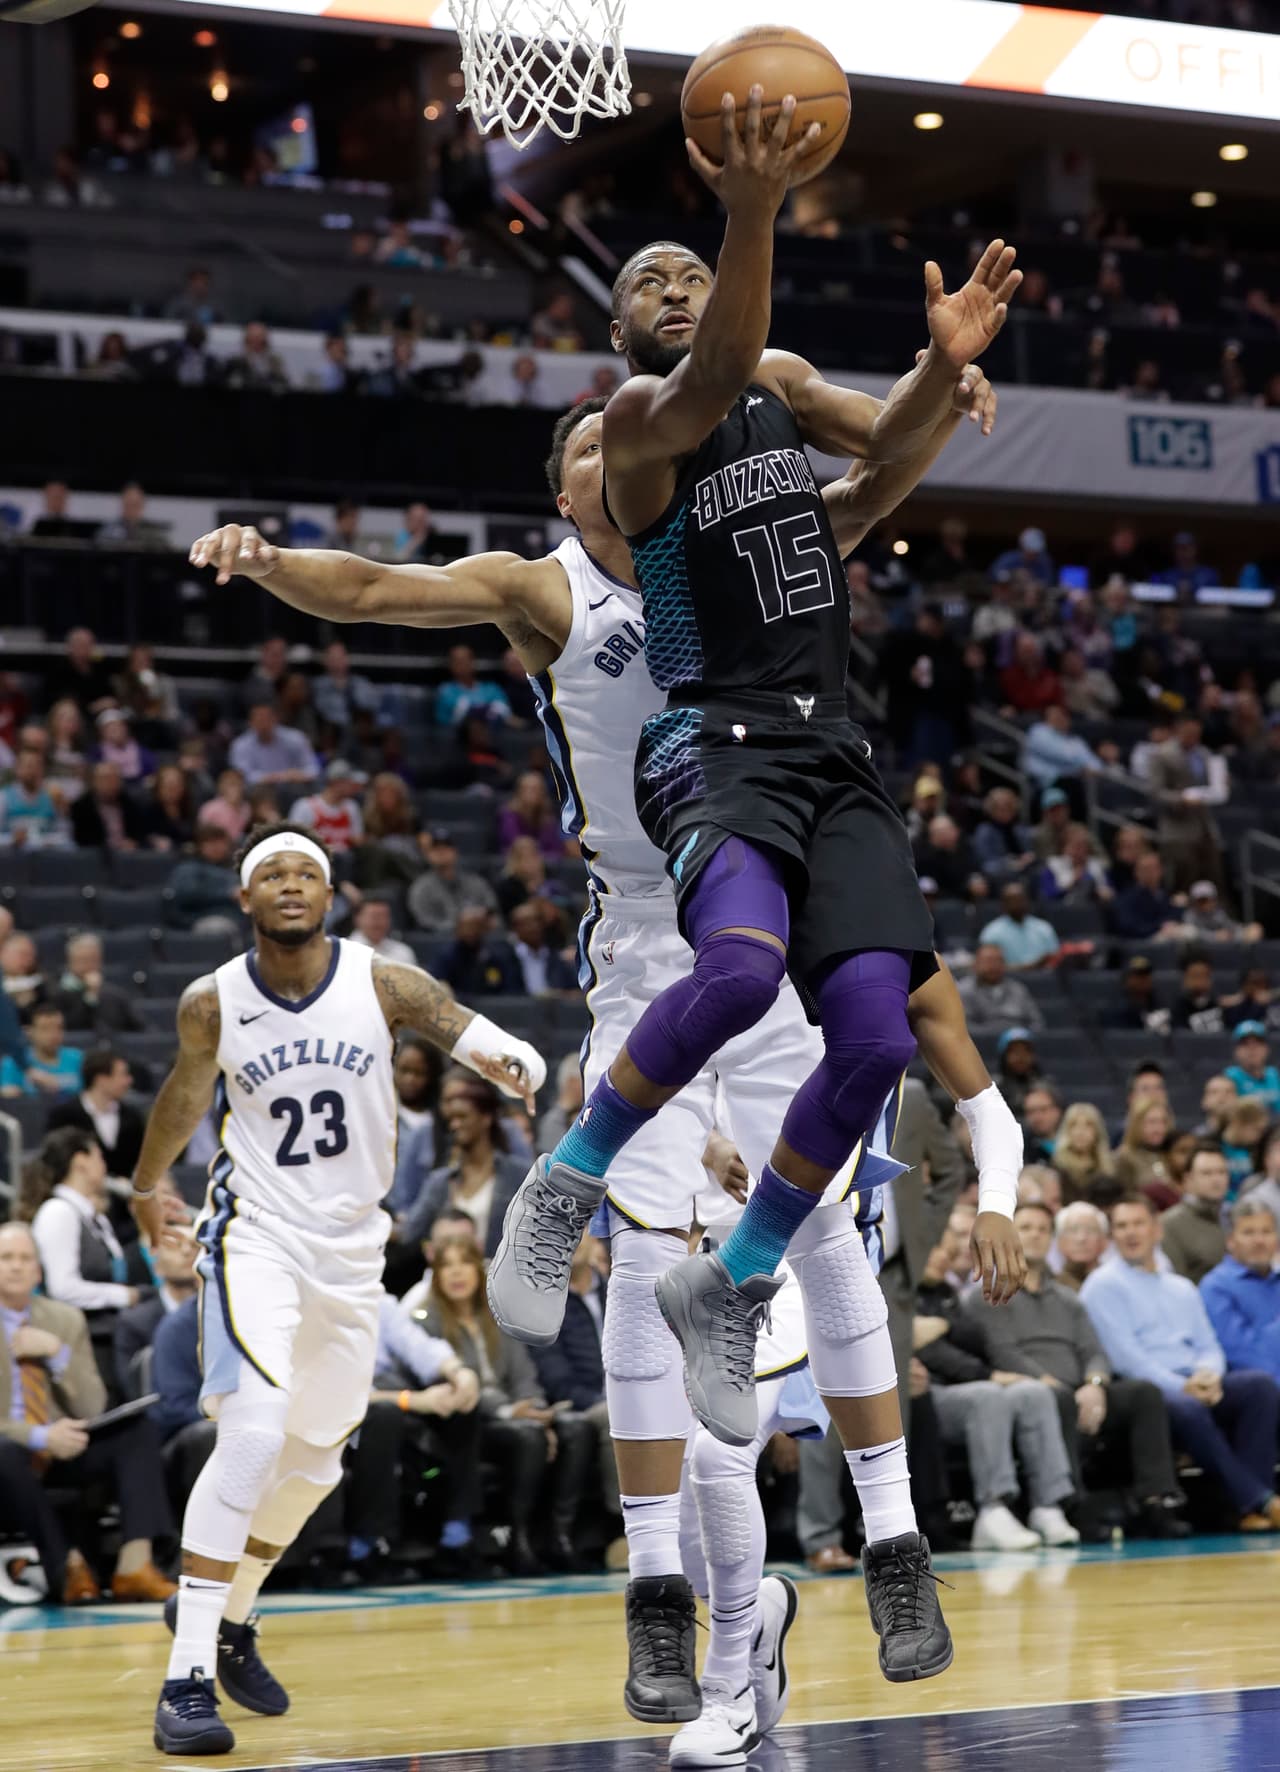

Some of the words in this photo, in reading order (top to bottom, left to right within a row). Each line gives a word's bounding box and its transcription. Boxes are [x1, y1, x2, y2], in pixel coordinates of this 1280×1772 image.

[1126, 38, 1280, 96] OFFI
[1135, 421, 1206, 466] 106
[732, 511, 835, 624] 15
[594, 620, 647, 678] GRI
[235, 1038, 375, 1095] GRIZZLIES
[270, 1090, 348, 1167] 23
